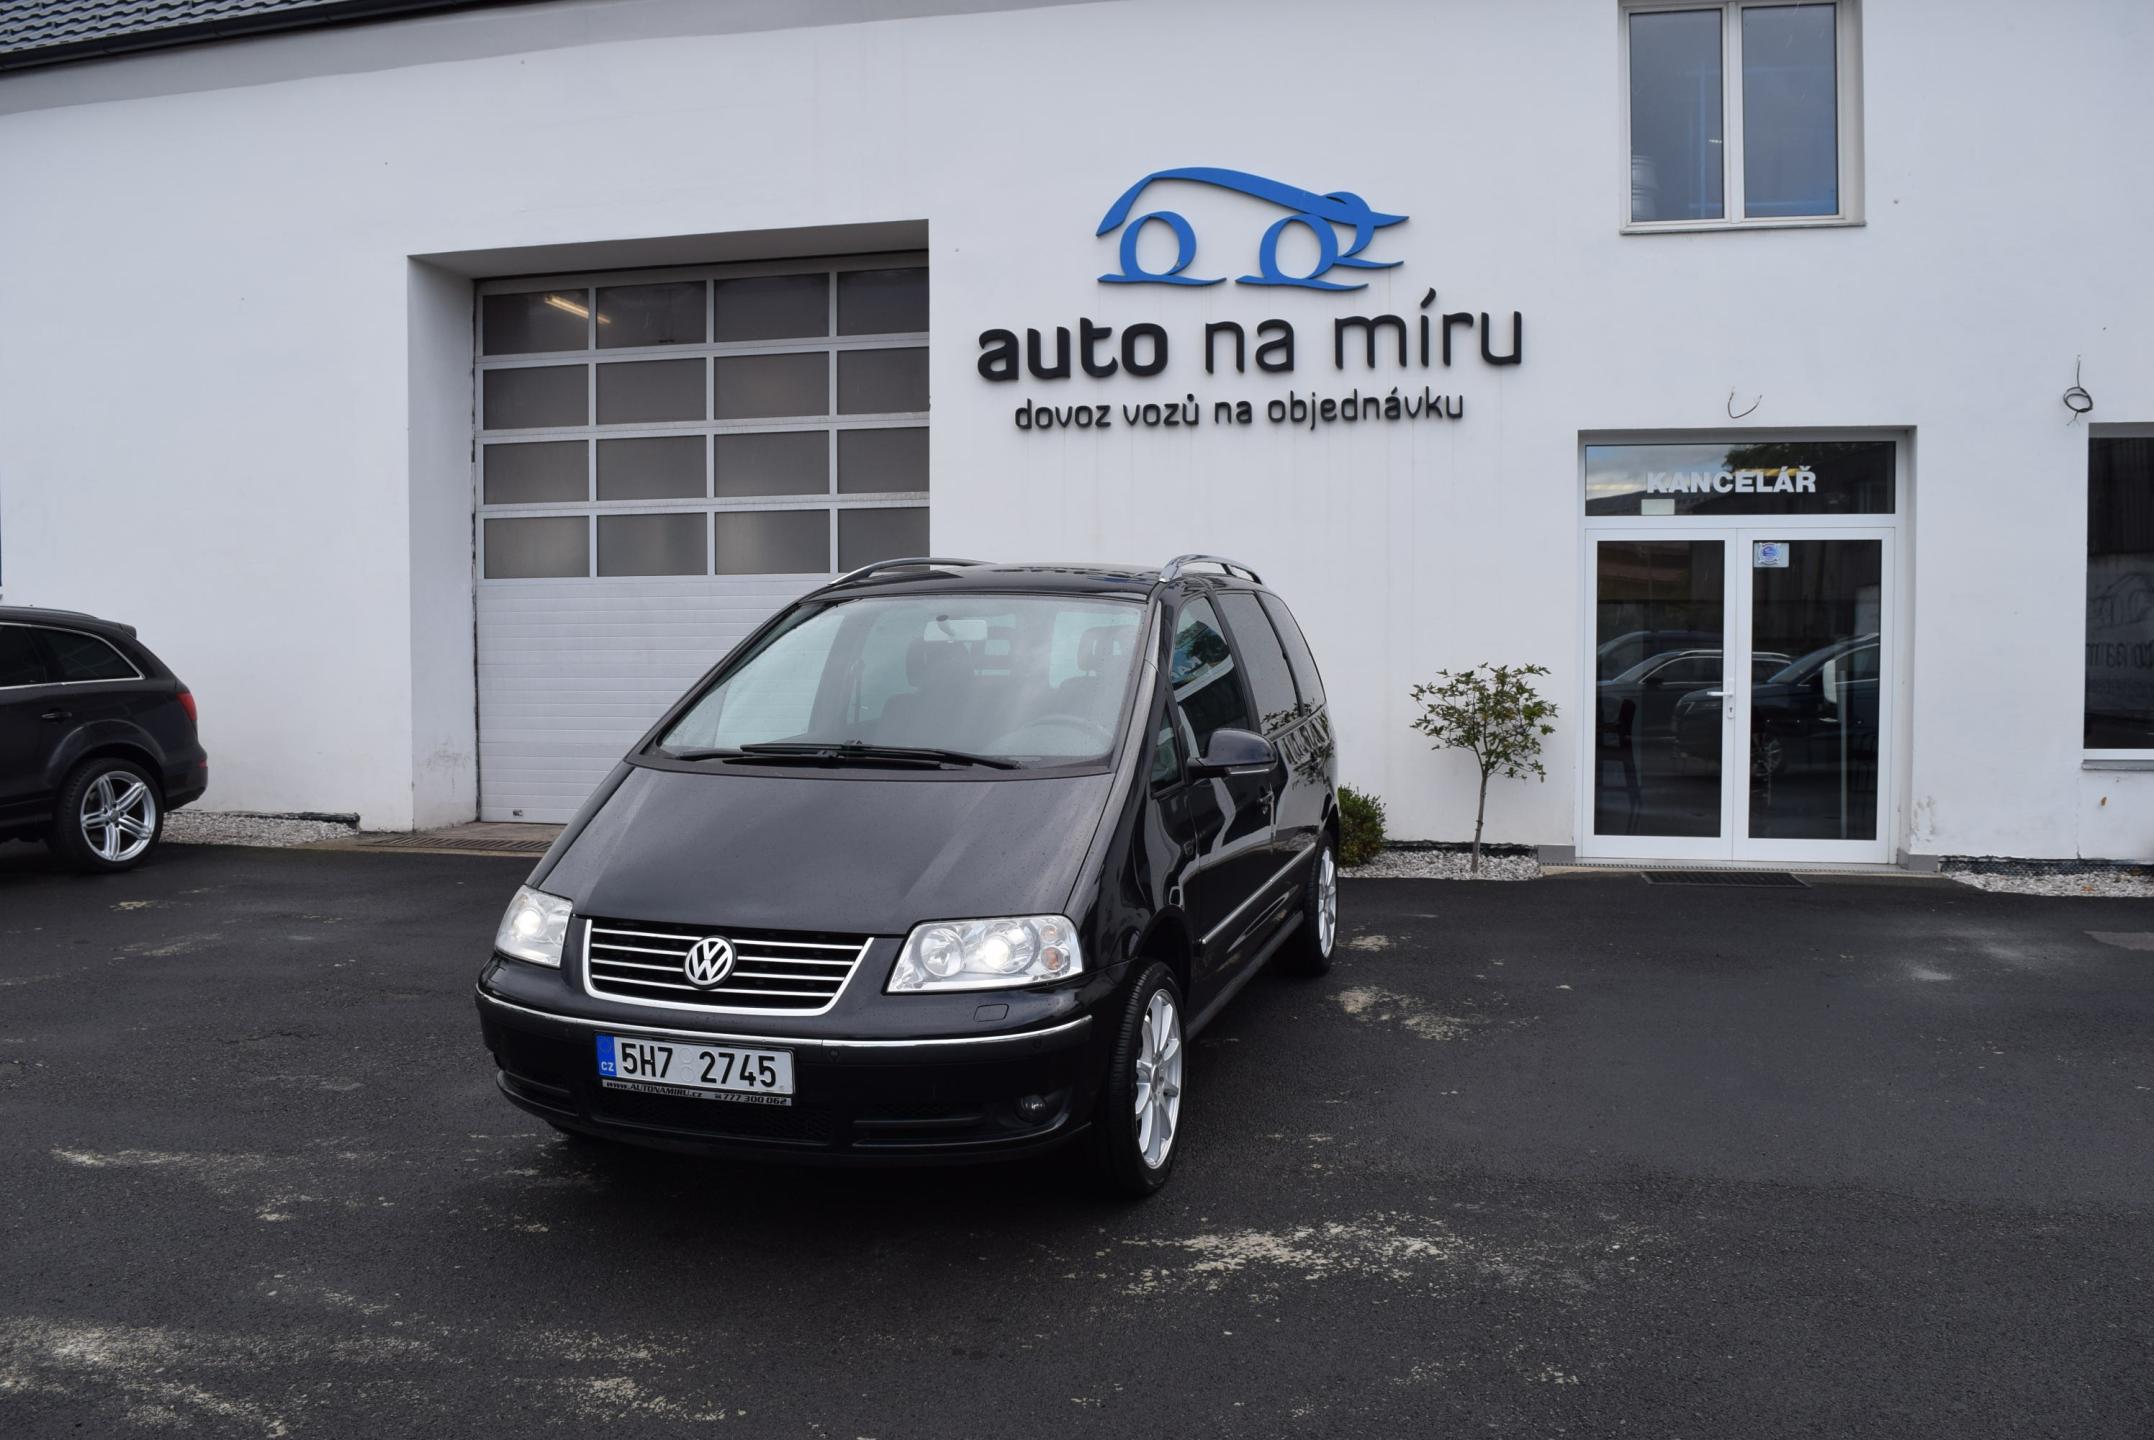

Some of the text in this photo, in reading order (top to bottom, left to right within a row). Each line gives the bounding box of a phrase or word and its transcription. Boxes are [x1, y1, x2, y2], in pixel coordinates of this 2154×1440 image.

[978, 287, 1522, 383] auto na míru
[1015, 386, 1463, 431] dovoz vozů na objednávku
[1647, 466, 1816, 493] KANCELÁŘ
[601, 1061, 615, 1072] CZ
[621, 1042, 776, 1088] 5H7 2745
